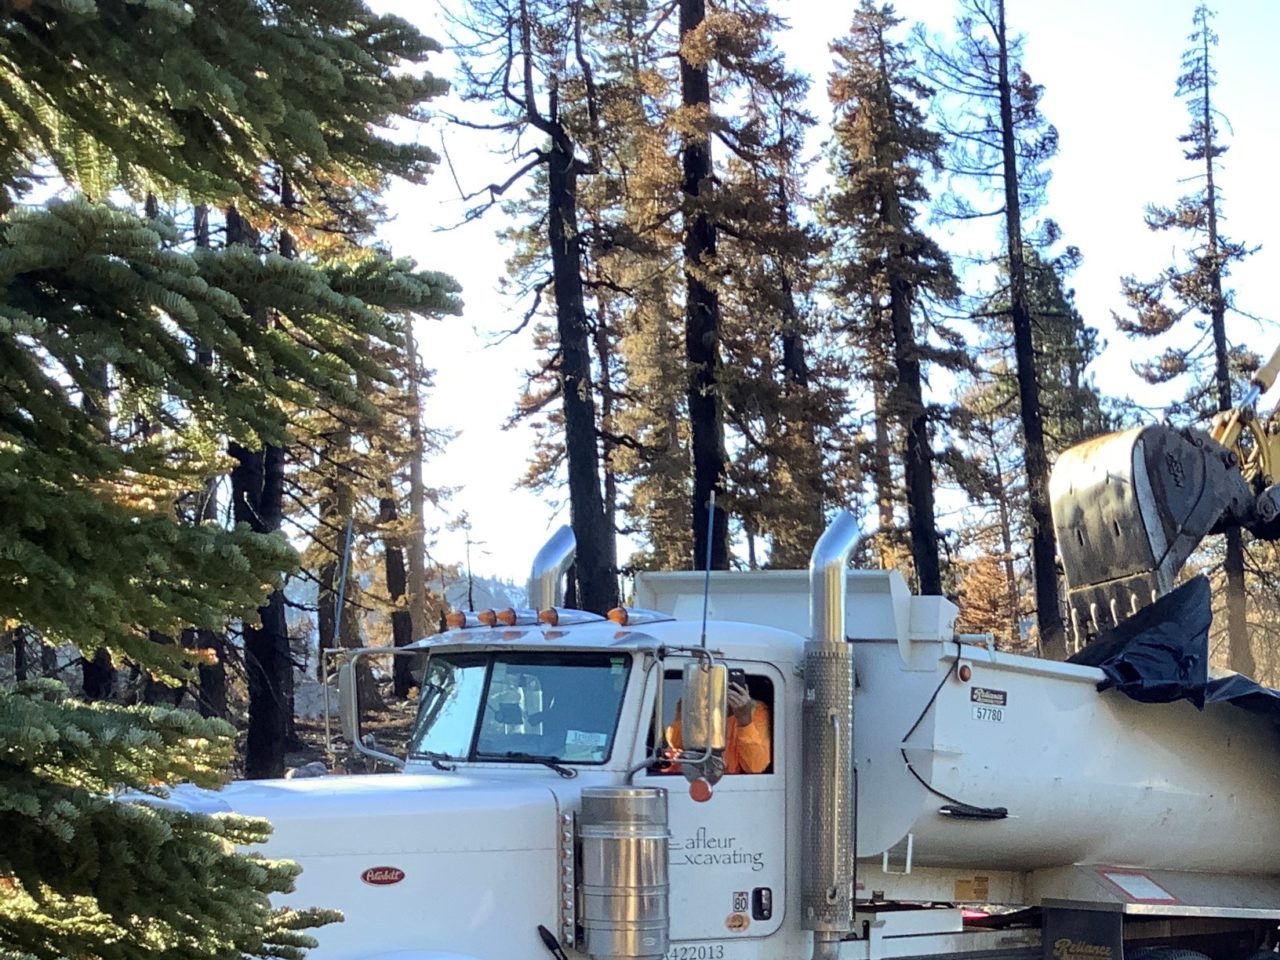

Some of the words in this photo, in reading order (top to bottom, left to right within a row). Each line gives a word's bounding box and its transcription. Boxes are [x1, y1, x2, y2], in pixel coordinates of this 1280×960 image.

[977, 708, 1002, 721] 57780
[669, 849, 765, 872] xcavating
[735, 897, 747, 910] 80
